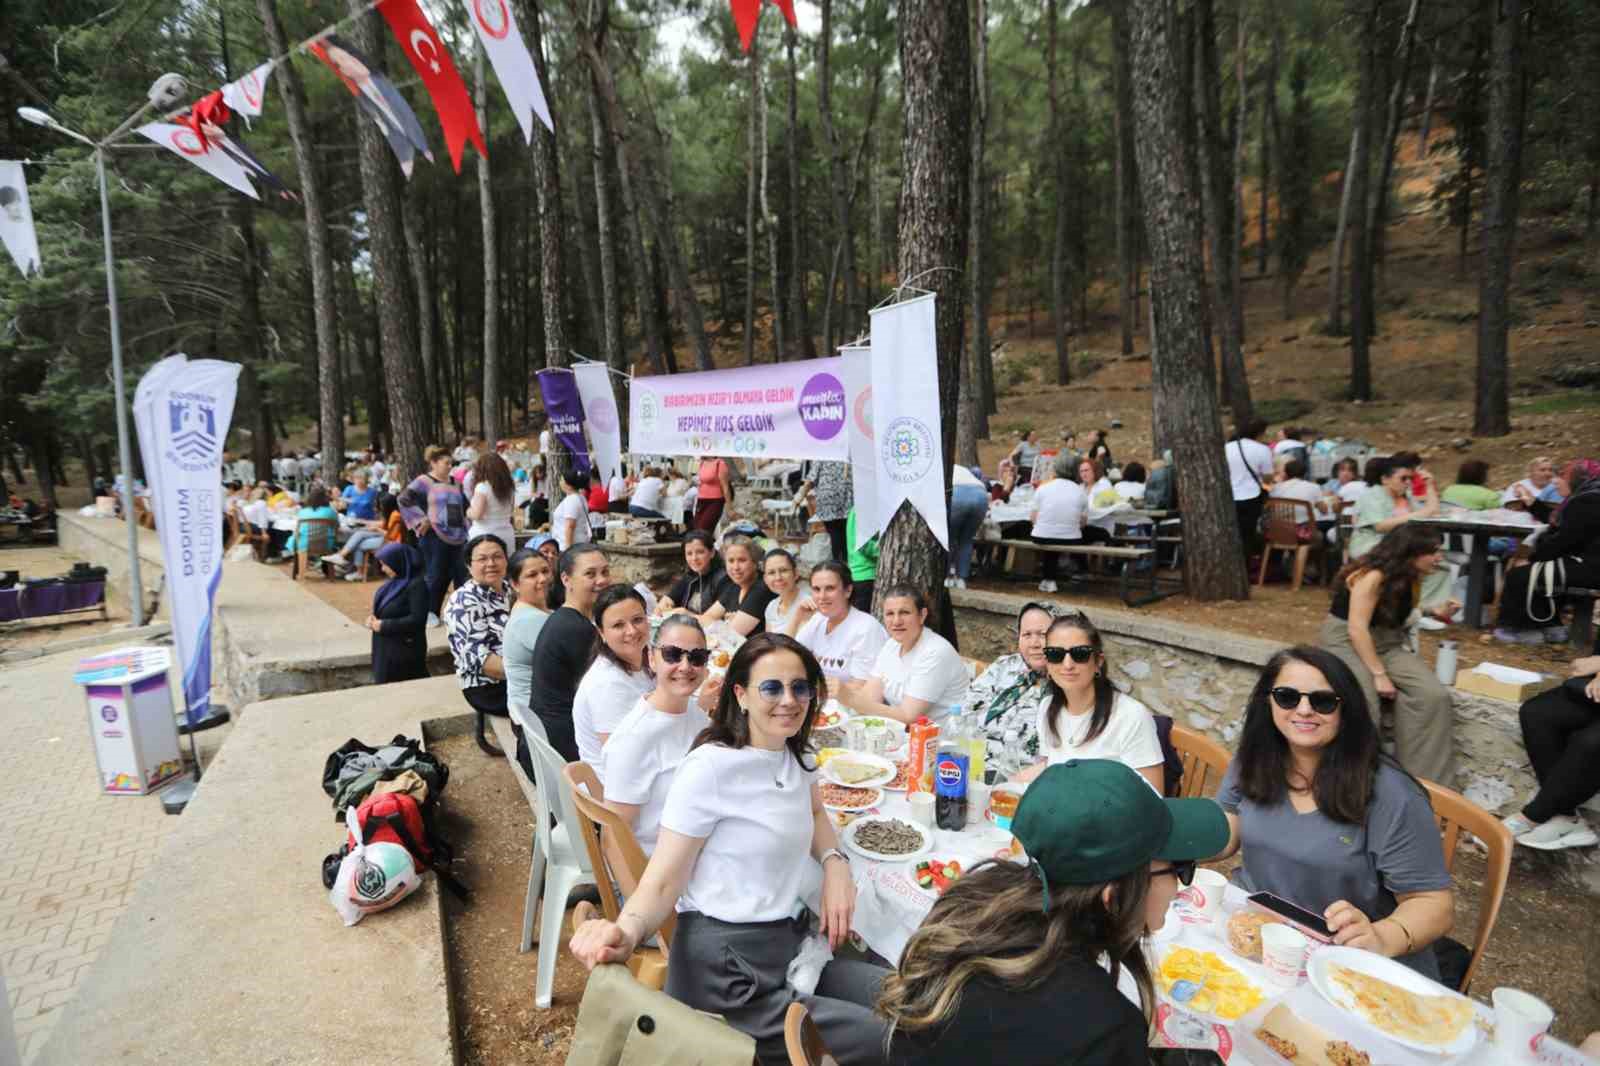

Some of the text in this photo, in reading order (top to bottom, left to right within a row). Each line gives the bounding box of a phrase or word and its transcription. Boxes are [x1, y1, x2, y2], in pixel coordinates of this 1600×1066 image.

[678, 411, 712, 433] HEPİMİZ
[714, 414, 735, 436] HOŞ
[737, 411, 775, 433] GELDİK
[802, 405, 843, 421] KADIN
[178, 488, 193, 577] BODRUM
